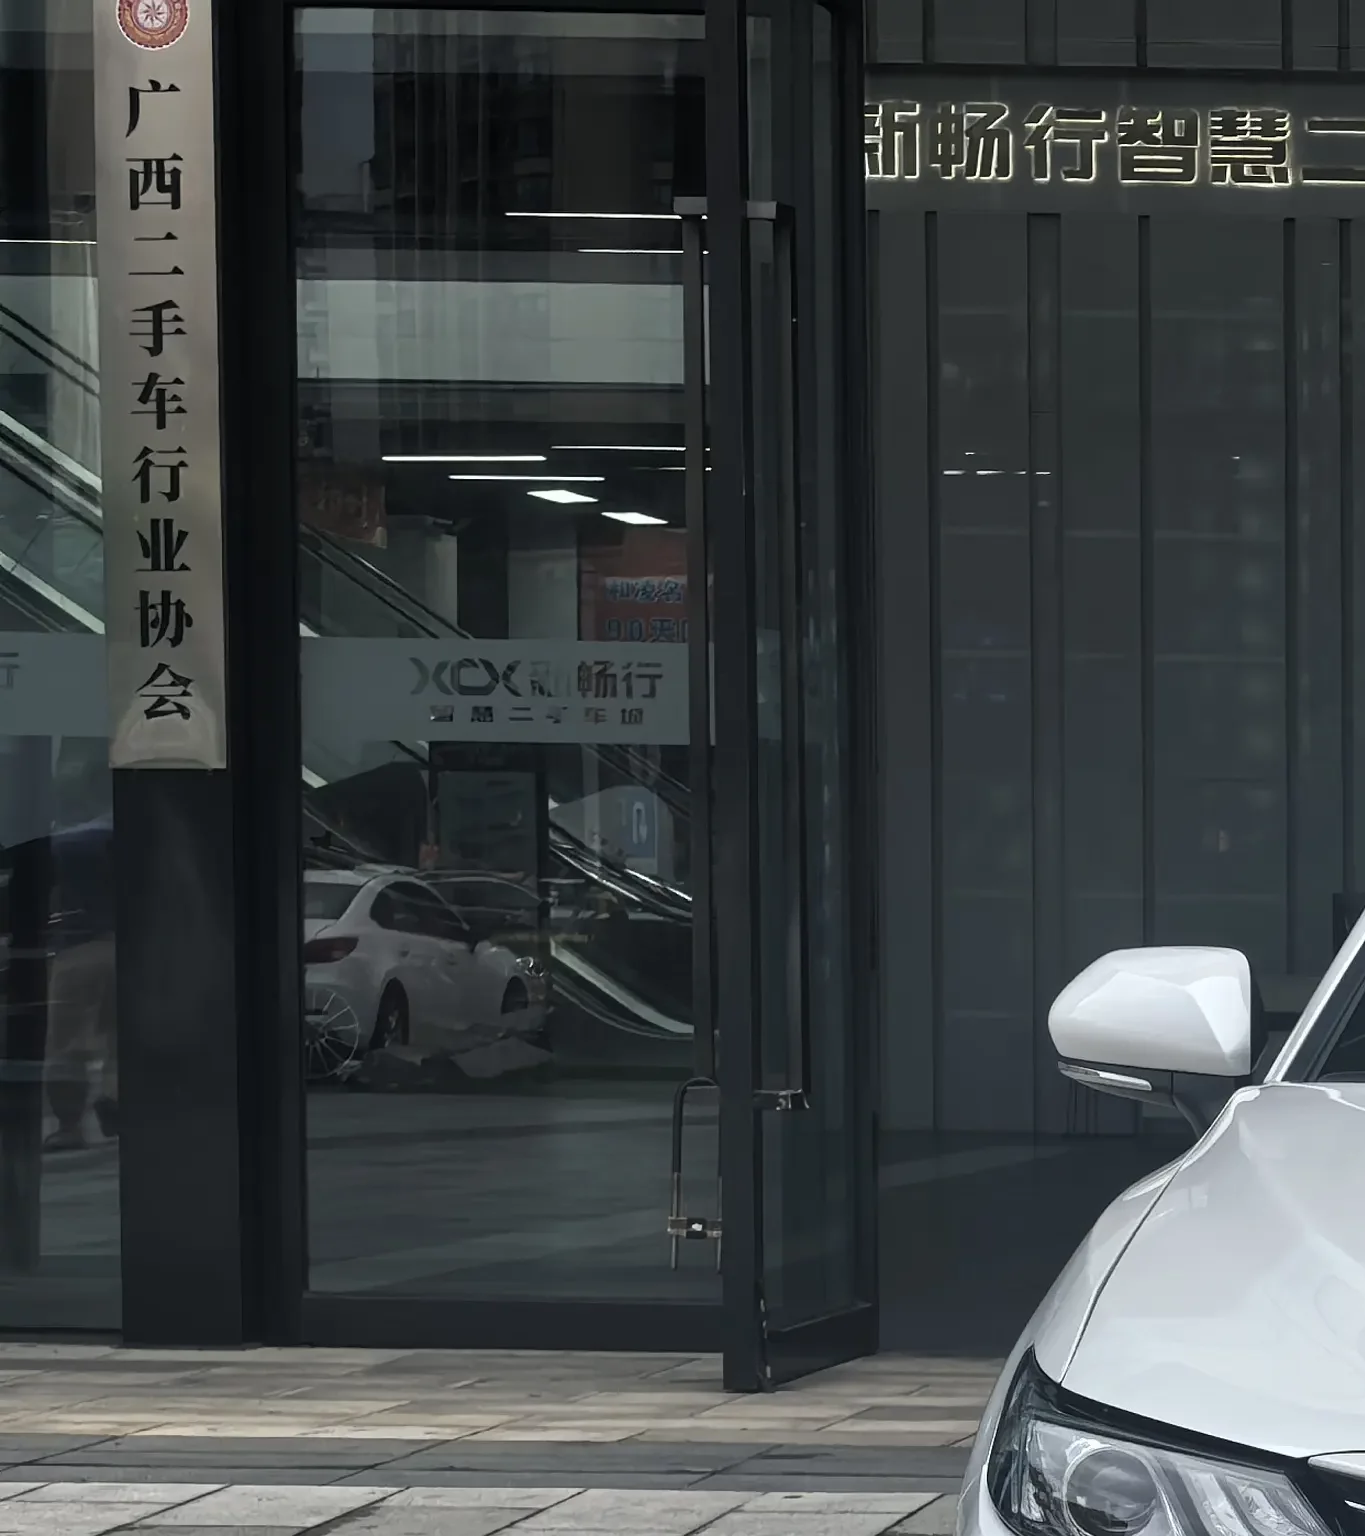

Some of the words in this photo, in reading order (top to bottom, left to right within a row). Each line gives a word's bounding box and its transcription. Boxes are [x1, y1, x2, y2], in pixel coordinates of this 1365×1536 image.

[125, 79, 194, 722] 广西二手车行业协会
